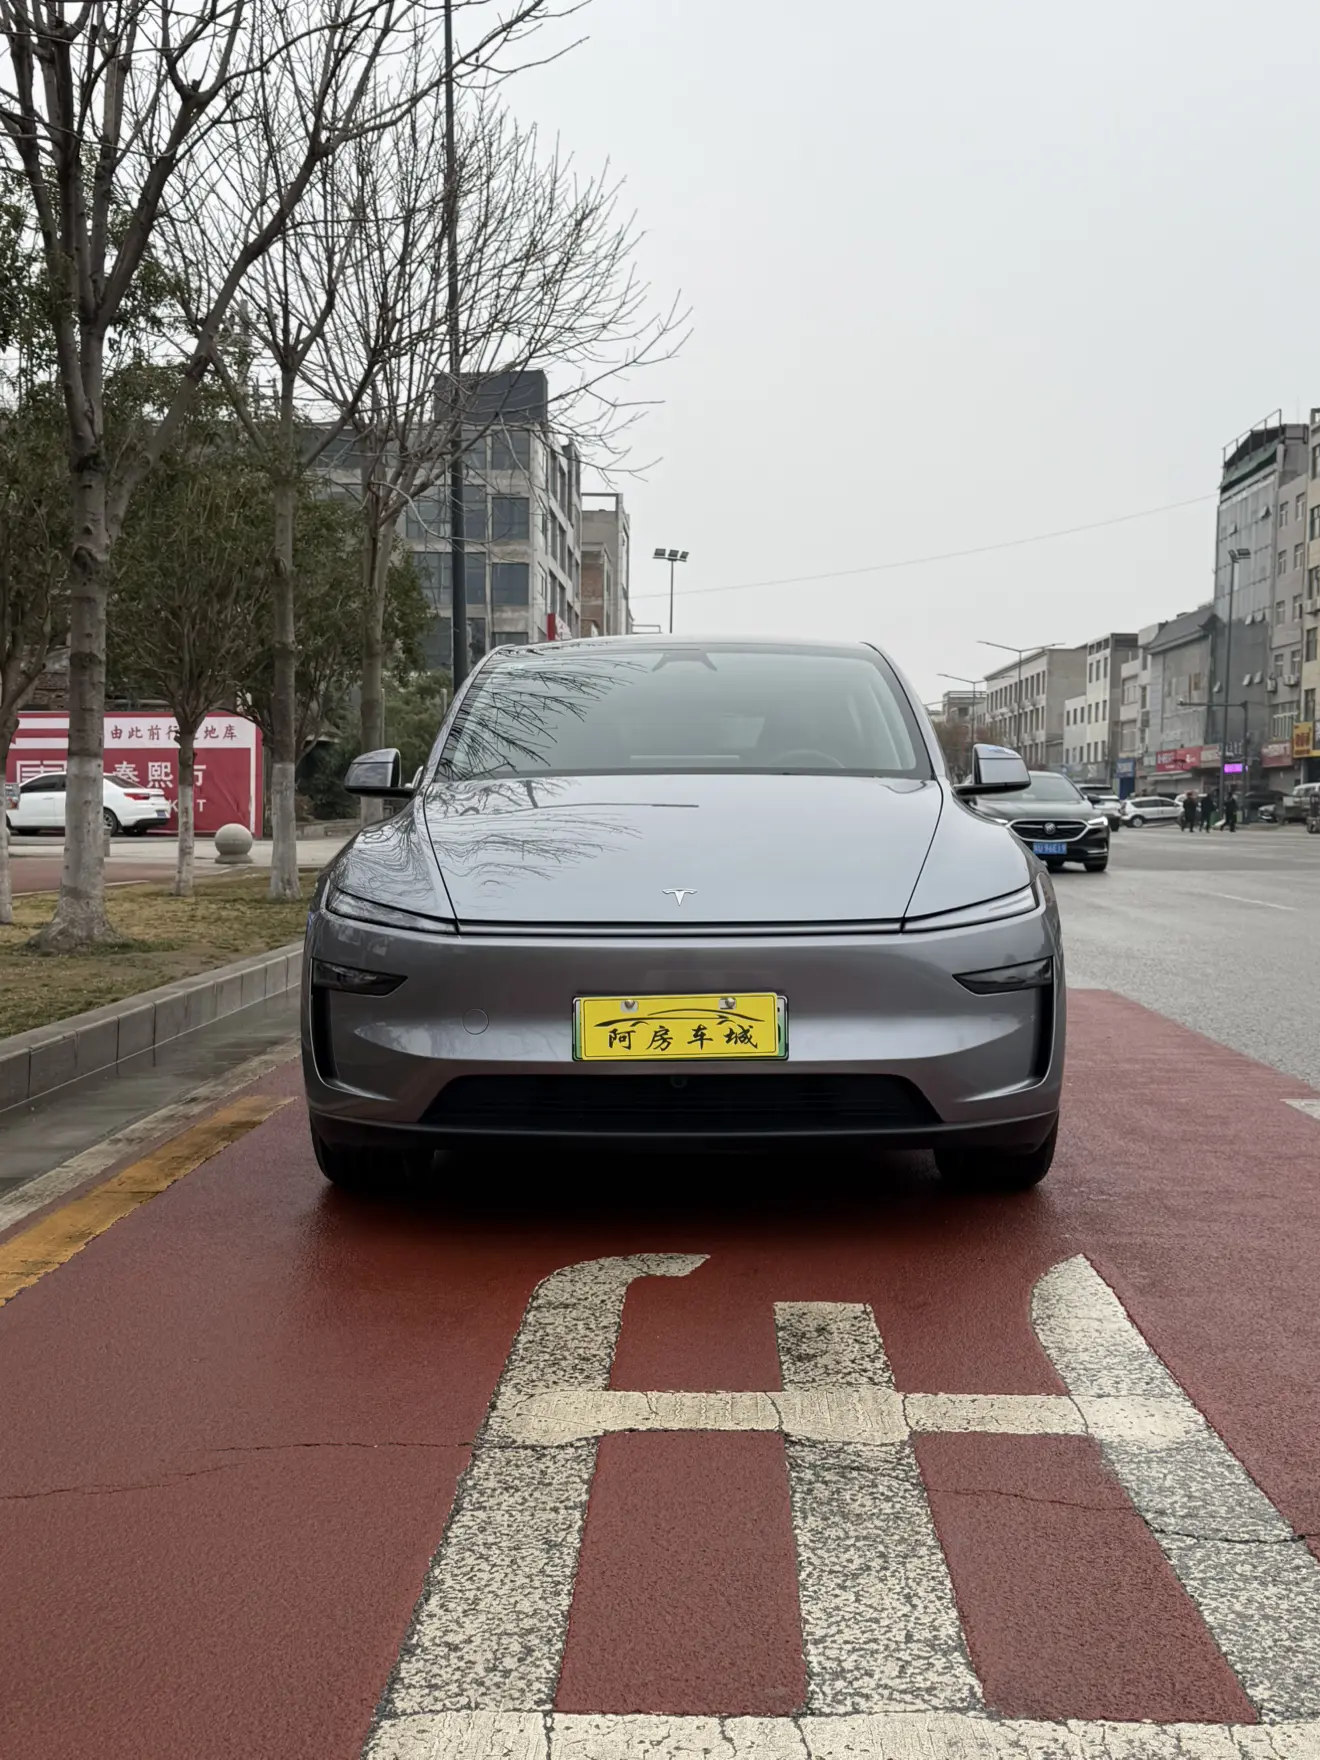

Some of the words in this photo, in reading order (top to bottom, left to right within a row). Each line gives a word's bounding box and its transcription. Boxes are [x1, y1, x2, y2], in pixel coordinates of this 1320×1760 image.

[111, 724, 236, 740] 由此前行地库
[608, 1024, 758, 1051] 阿房车城
